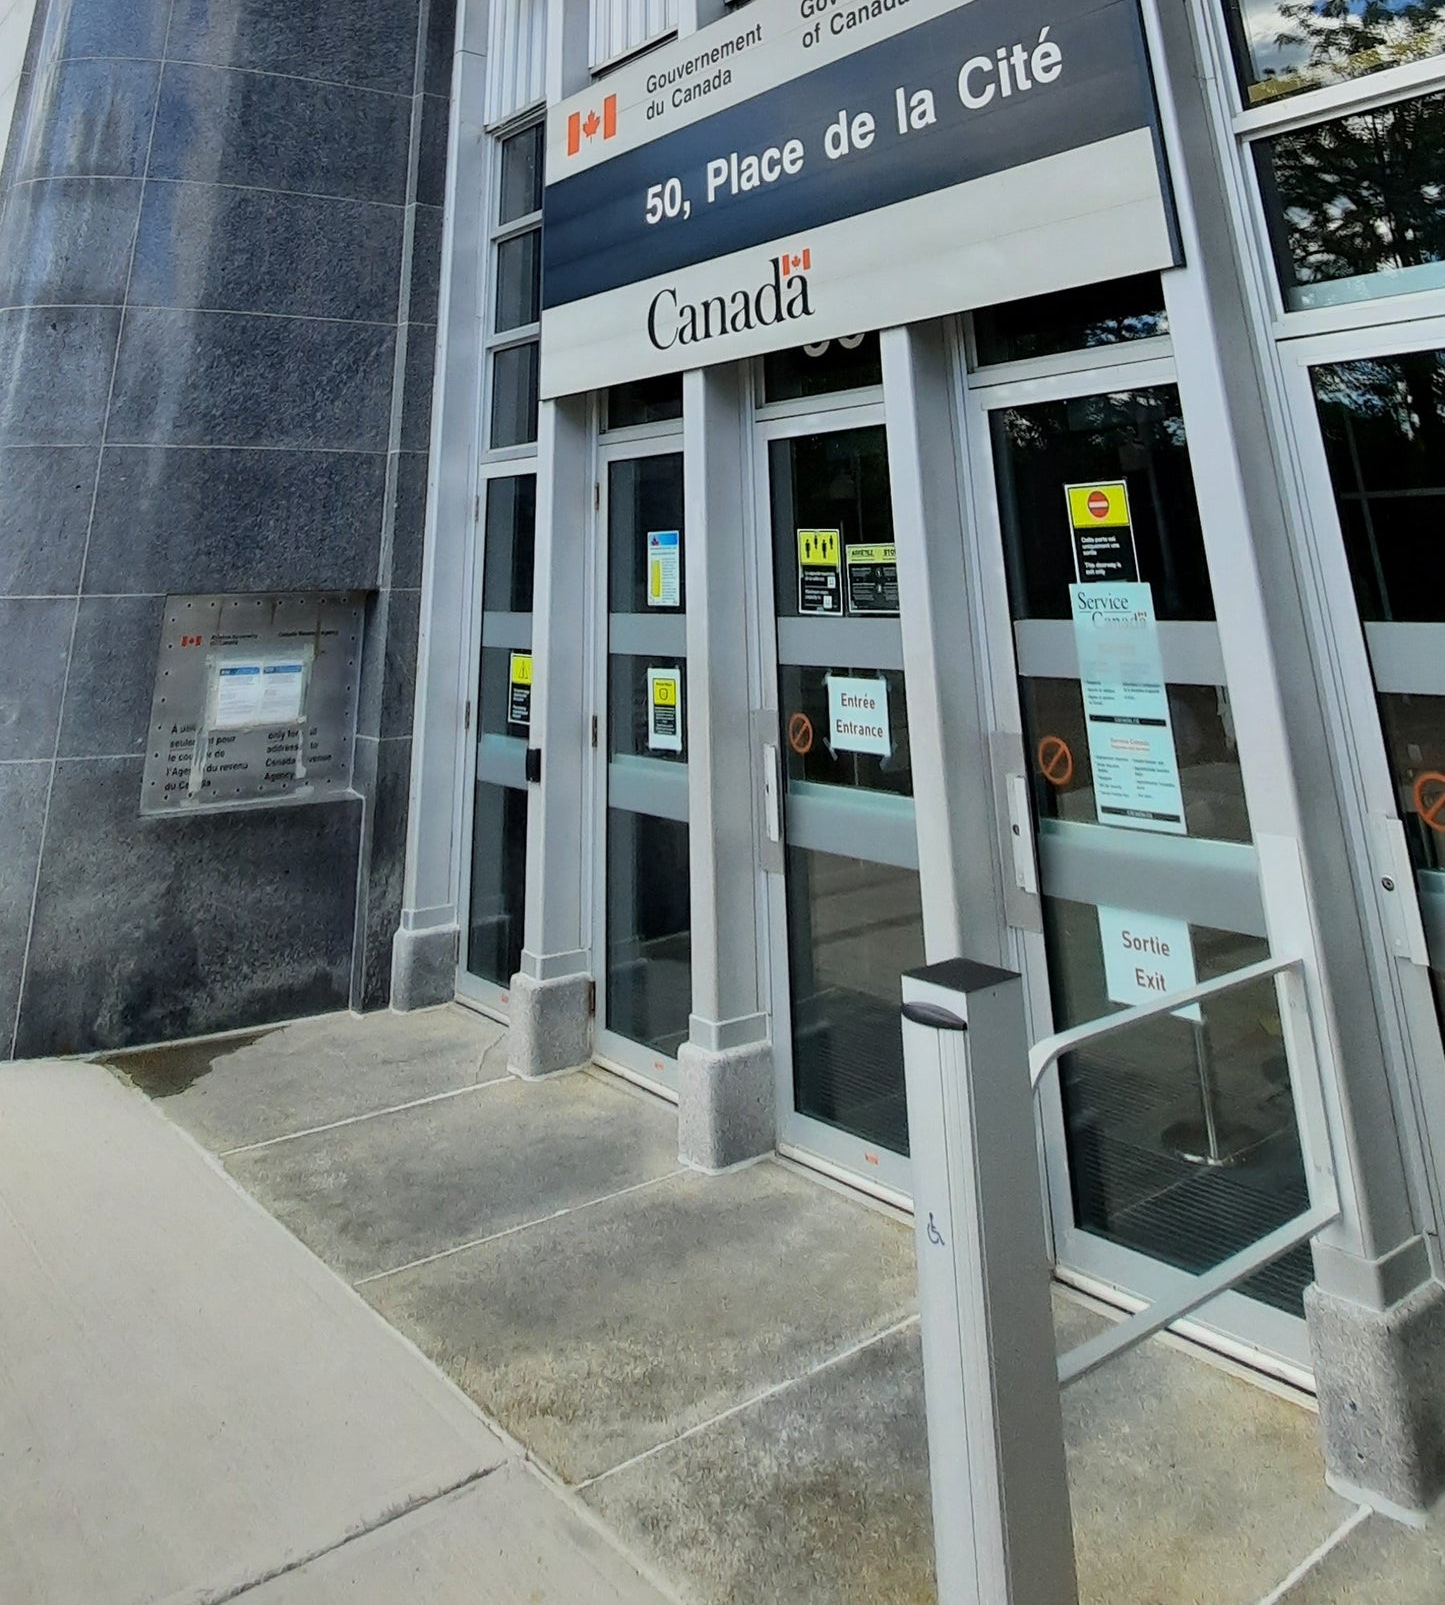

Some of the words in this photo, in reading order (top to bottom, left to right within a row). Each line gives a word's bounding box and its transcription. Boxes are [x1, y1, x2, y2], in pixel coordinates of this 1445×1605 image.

[802, 24, 821, 49] of
[646, 23, 763, 94] Gouvernement
[646, 101, 665, 121] du
[671, 67, 732, 110] Canada
[645, 177, 692, 225] 50,
[706, 137, 805, 204] Place
[824, 109, 876, 160] de
[895, 86, 938, 135] la
[957, 26, 1063, 110] Cité
[647, 256, 816, 351] Canada
[1077, 591, 1130, 610] Service
[841, 692, 876, 710] Entrée
[836, 718, 884, 738] Entrance
[1121, 929, 1170, 957] Sortie
[1135, 967, 1167, 992] Exit
